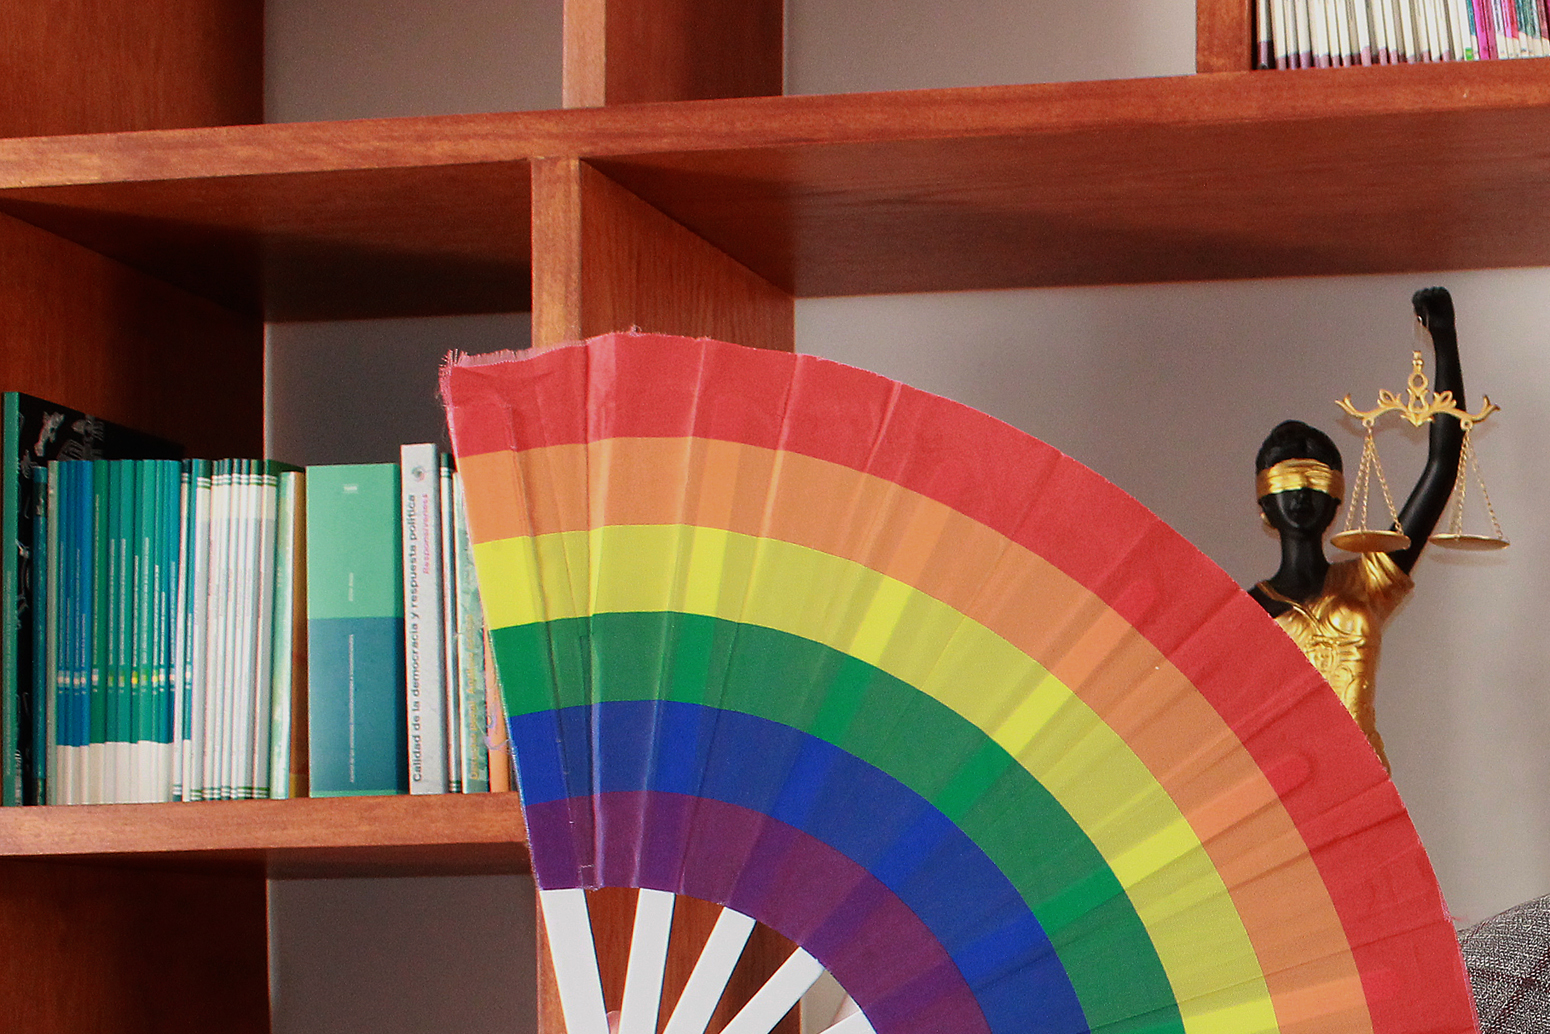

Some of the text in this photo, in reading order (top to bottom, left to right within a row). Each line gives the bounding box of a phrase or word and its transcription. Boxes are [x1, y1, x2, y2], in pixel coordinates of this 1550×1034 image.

[408, 544, 418, 608] respuesta
[409, 623, 419, 696] democracia
[411, 700, 419, 711] la
[411, 715, 420, 730] de
[411, 735, 421, 781] Calidad
